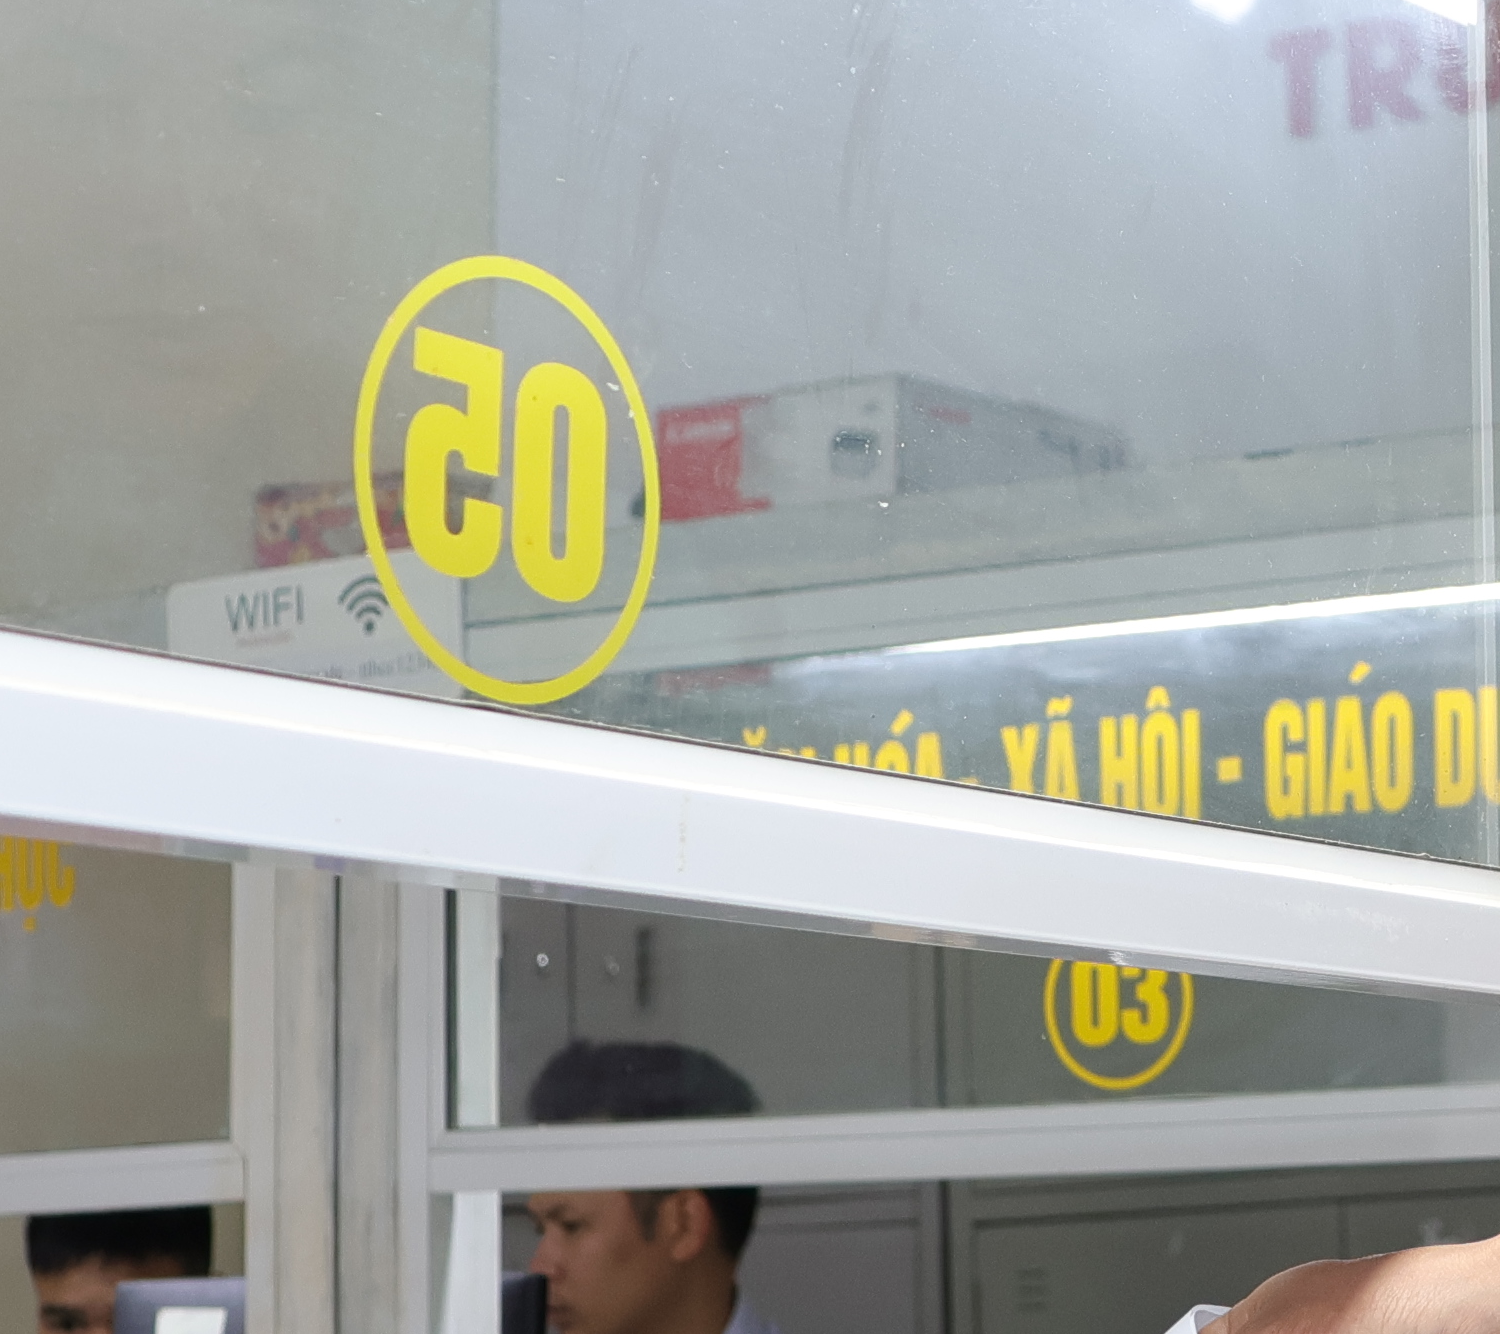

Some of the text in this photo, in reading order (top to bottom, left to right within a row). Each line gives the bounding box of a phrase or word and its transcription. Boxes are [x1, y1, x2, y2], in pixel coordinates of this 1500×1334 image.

[225, 585, 304, 634] WIFI
[1264, 661, 1414, 819] GIÁO
[1071, 961, 1169, 1047] 03
